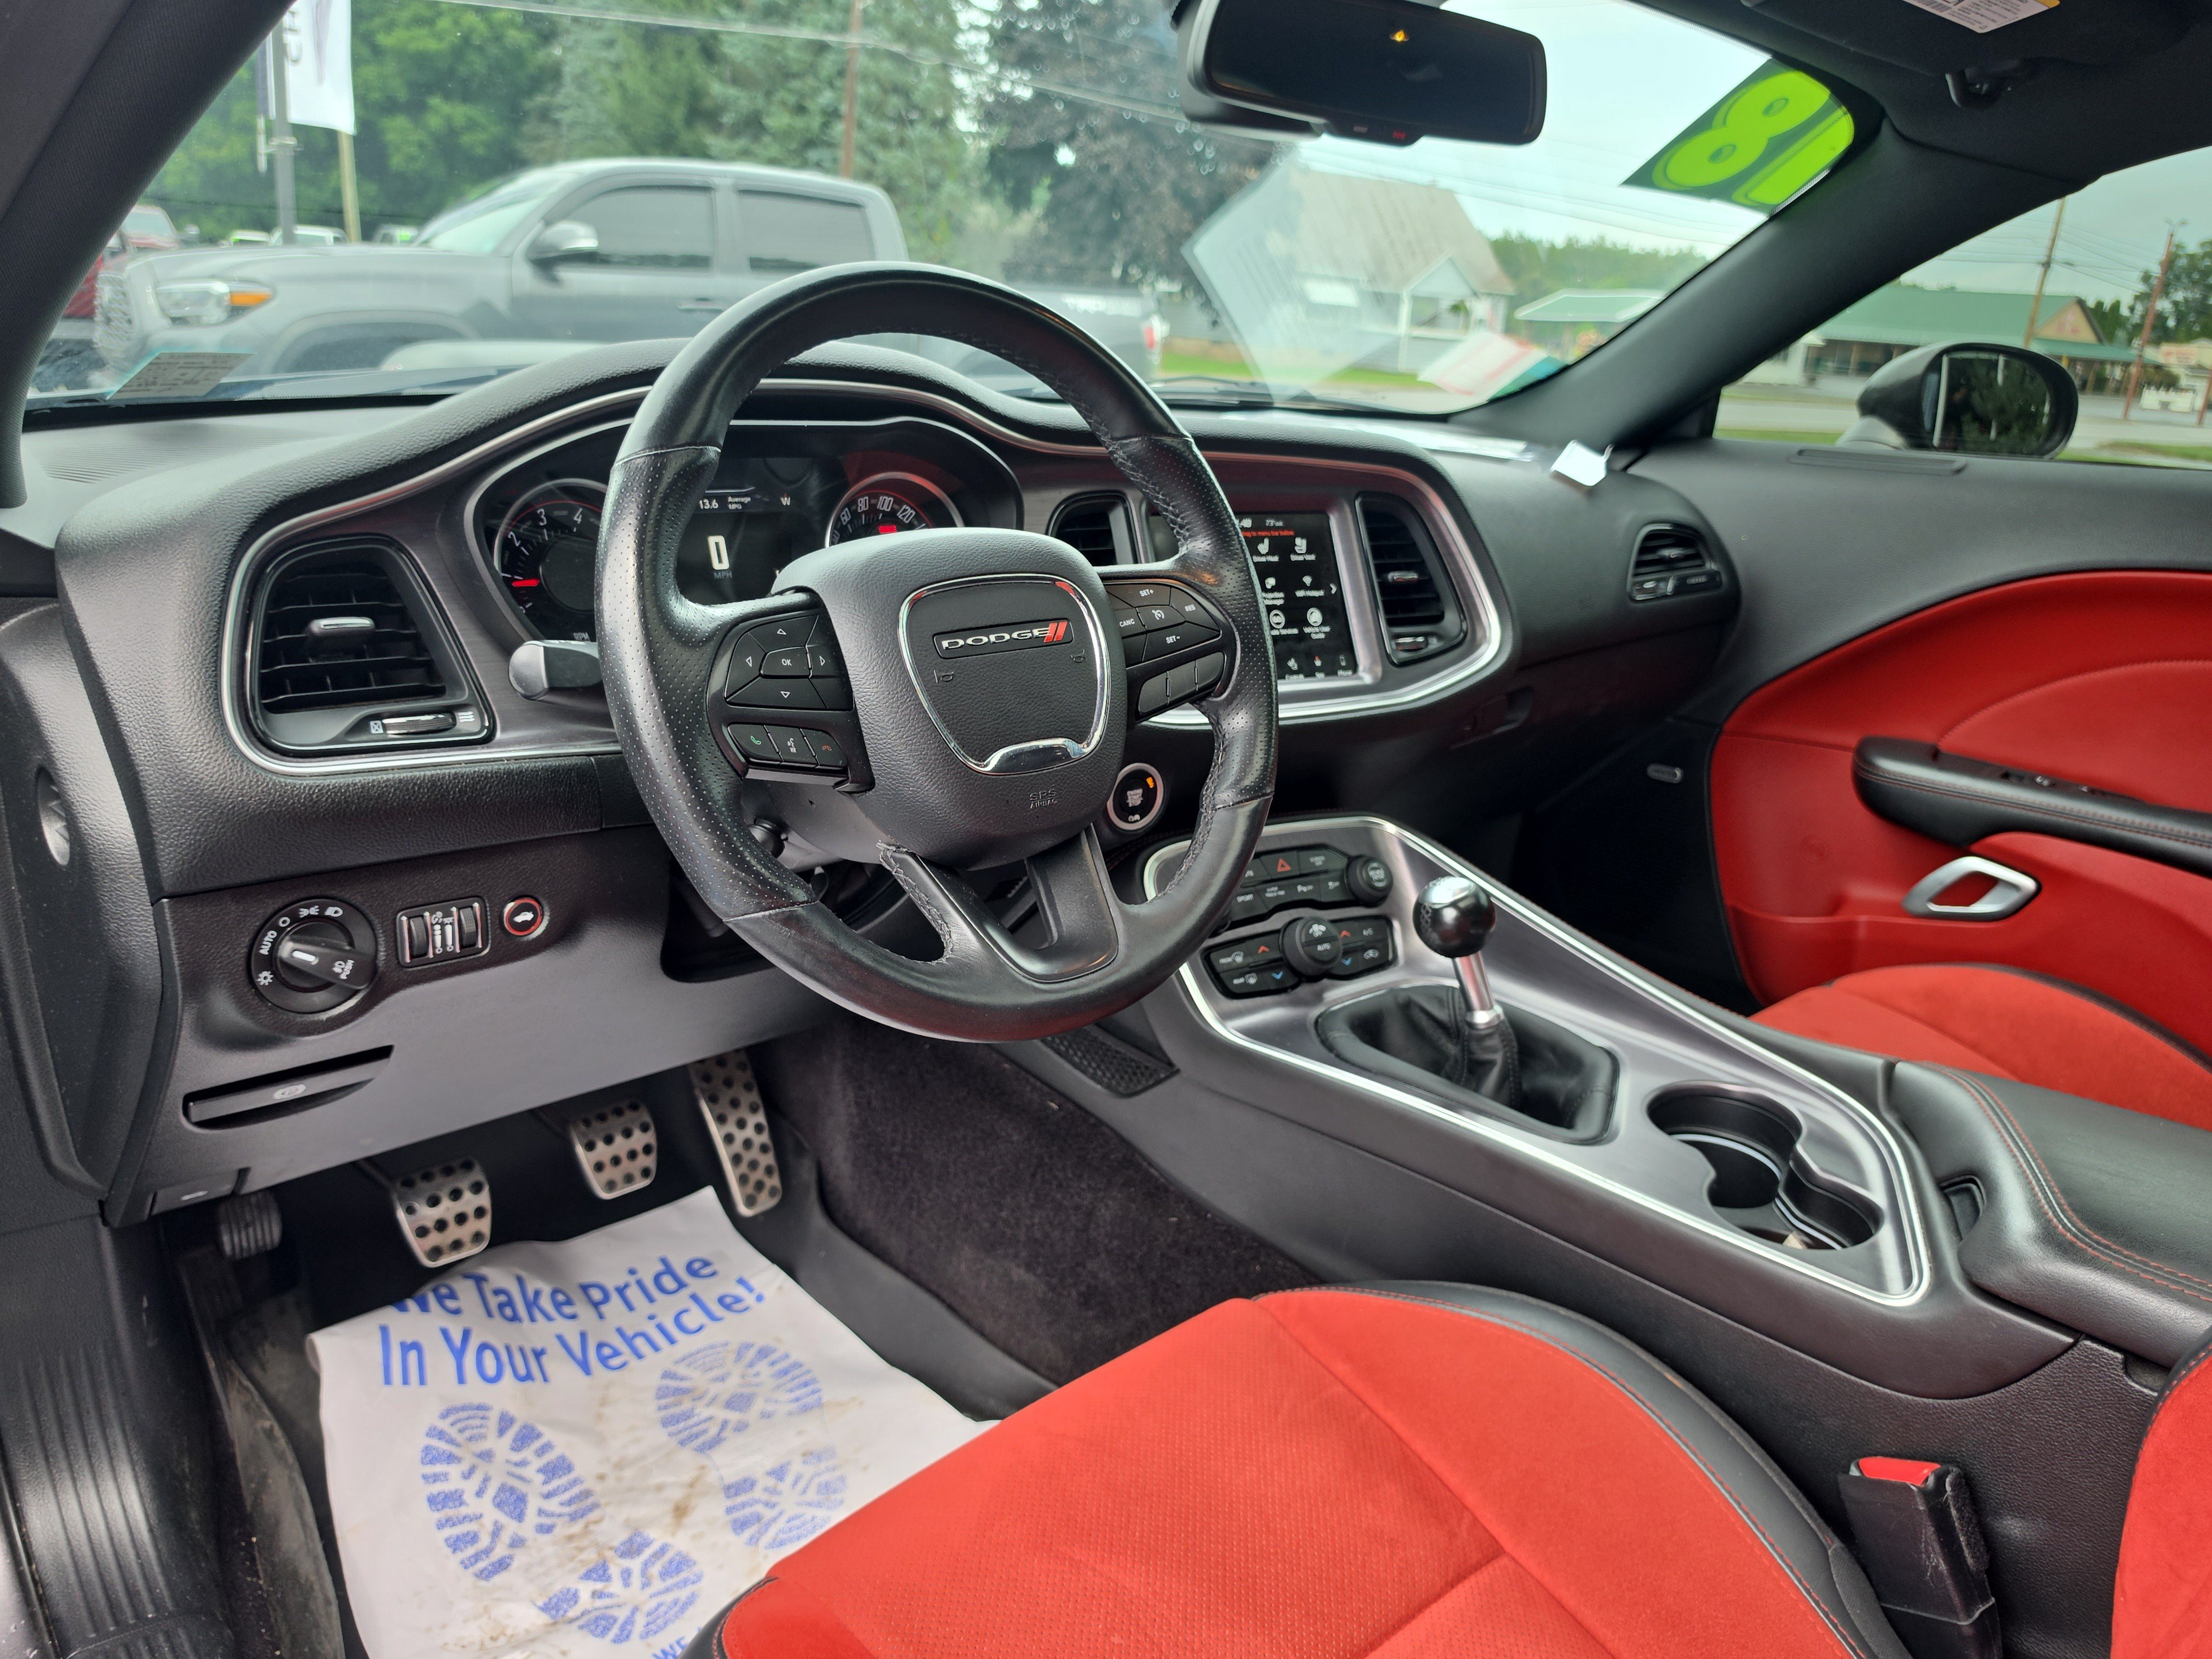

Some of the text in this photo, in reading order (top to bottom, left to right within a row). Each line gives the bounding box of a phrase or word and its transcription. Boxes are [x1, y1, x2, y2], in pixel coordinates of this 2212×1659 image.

[699, 498, 719, 510] 13.6
[857, 496, 870, 513] 80
[877, 496, 894, 511] 100
[537, 509, 546, 526] 3
[573, 507, 582, 524] 4
[840, 507, 851, 526] 60
[897, 504, 916, 524] 120
[507, 531, 521, 546] 2
[708, 535, 730, 570] 0
[1139, 588, 1154, 597] SET+
[1185, 604, 1196, 612] RES
[1119, 618, 1135, 627] CANC
[941, 627, 1052, 650] DODGE
[1166, 635, 1181, 644] SET-
[782, 658, 792, 666] OK
[1237, 893, 1253, 902] SPORT
[259, 930, 277, 955] AUTO
[1317, 942, 1332, 951] AUTO
[339, 959, 355, 980] PUSH
[462, 1272, 579, 1324] Take
[580, 1255, 719, 1320] Pride
[379, 1276, 766, 1386] In Your Vehicle!
